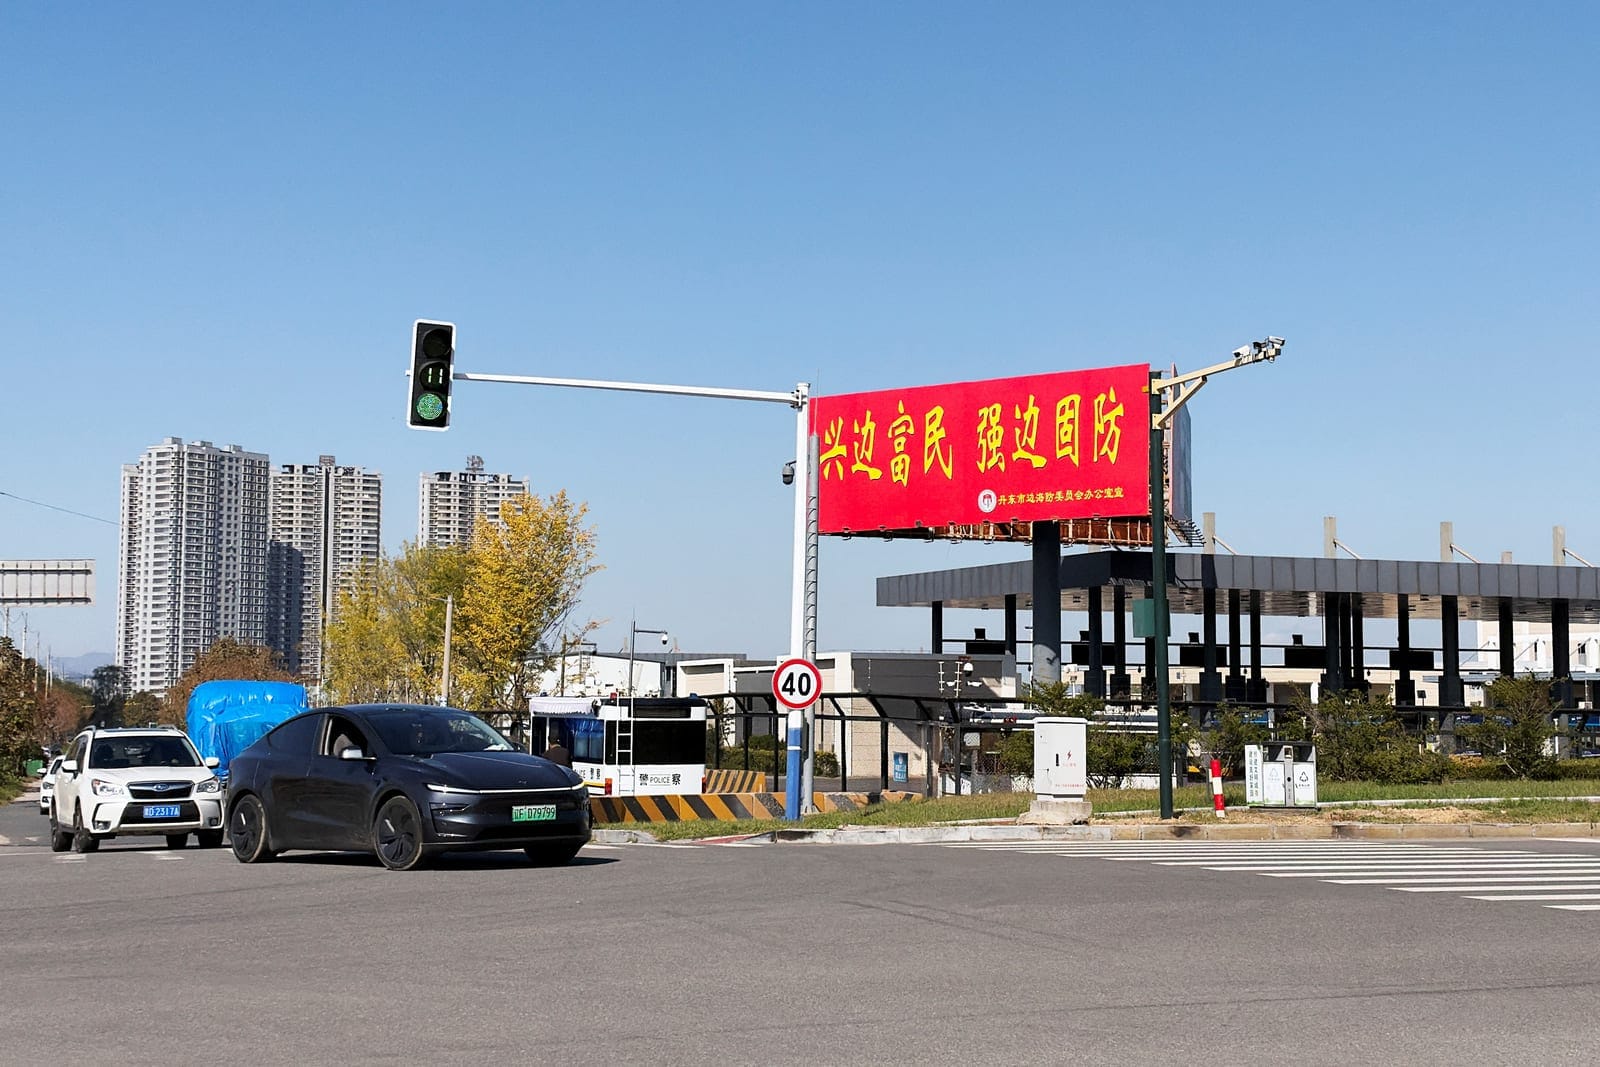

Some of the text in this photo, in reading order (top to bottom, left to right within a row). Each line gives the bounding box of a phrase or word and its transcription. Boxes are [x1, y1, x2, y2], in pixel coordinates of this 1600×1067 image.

[428, 367, 444, 384] 11
[818, 386, 1125, 488] 兴边富民 强边固防
[998, 487, 1124, 505] 丹东市边海防委员会办公室宣
[781, 671, 812, 697] 40
[650, 776, 671, 784] POLICE
